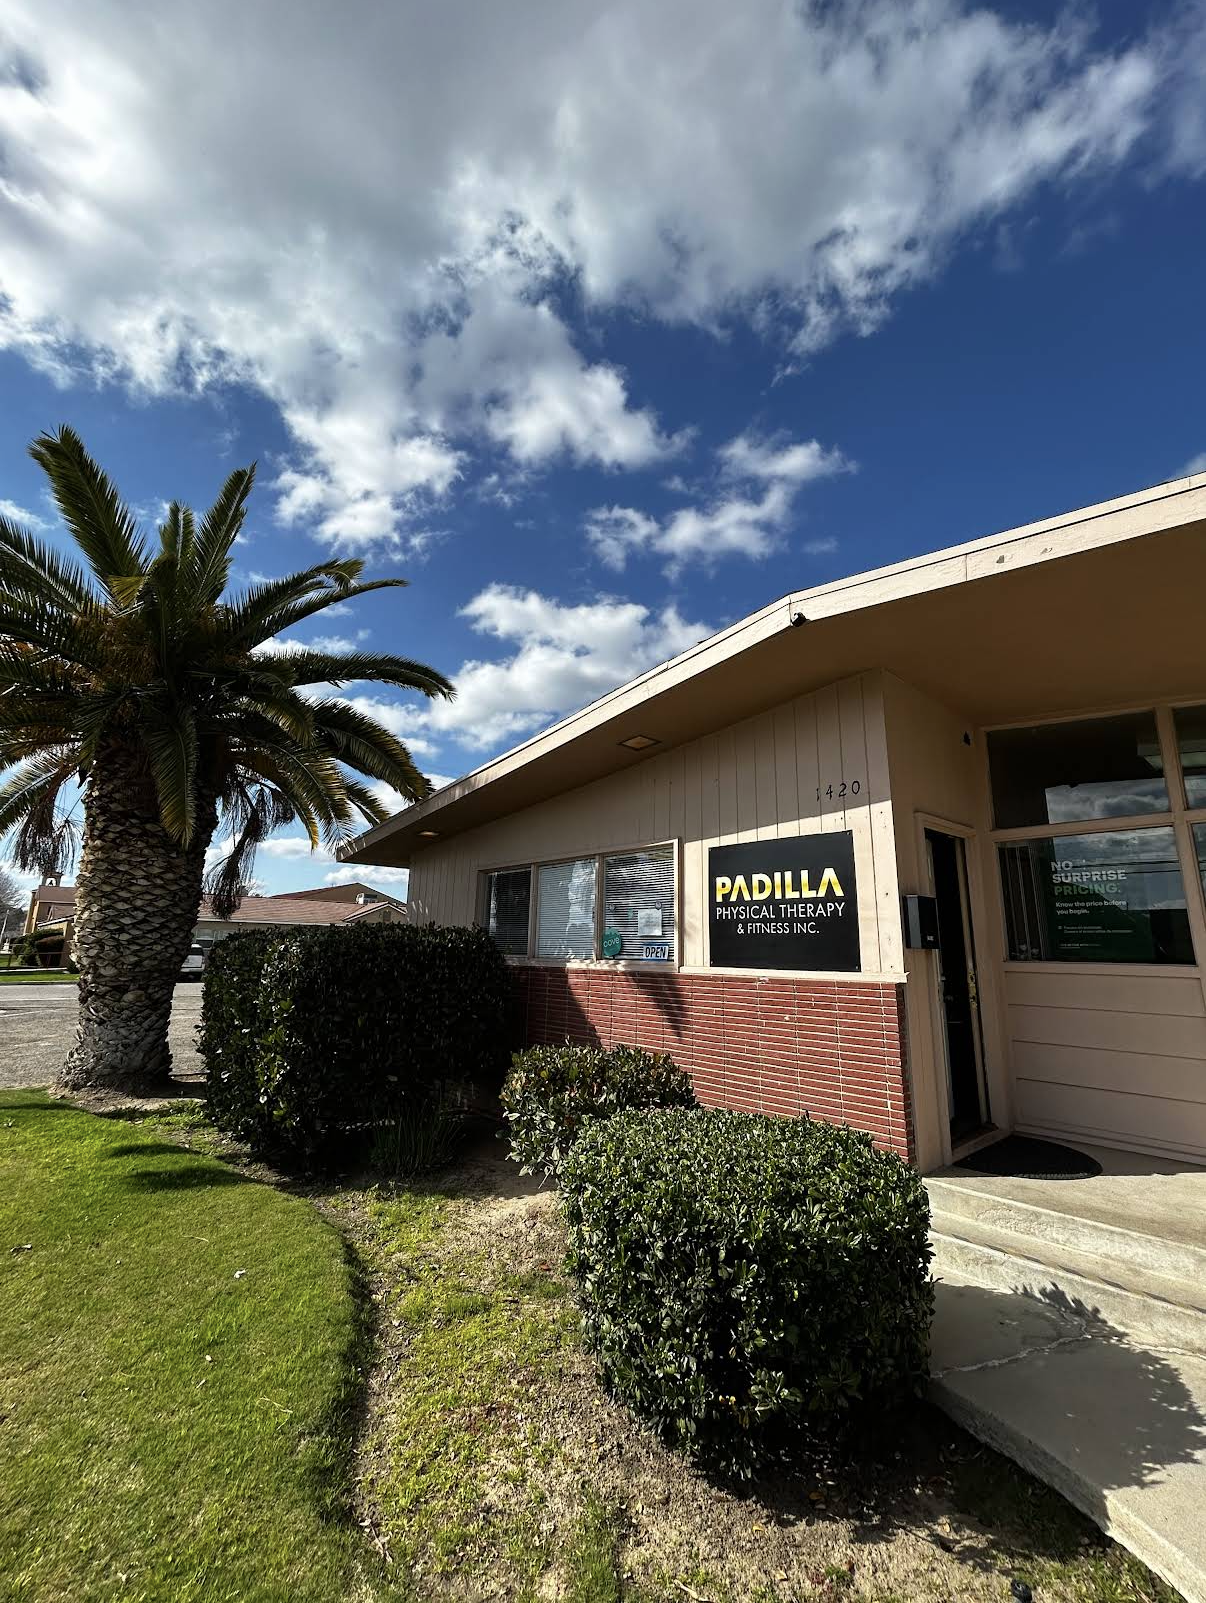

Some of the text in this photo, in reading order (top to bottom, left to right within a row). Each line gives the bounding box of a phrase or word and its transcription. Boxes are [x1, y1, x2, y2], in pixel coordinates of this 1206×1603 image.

[816, 780, 861, 802] 1420
[1050, 860, 1073, 872] NO
[1052, 869, 1127, 884] SURPRISE
[715, 867, 845, 903] PADILLA
[1054, 883, 1121, 896] PRICING.
[1086, 900, 1103, 908] price
[716, 902, 845, 920] PHYSICAL THERAPY
[737, 922, 820, 935] & FITNESS INC.
[603, 937, 620, 948] cove
[645, 946, 667, 958] OPEN
